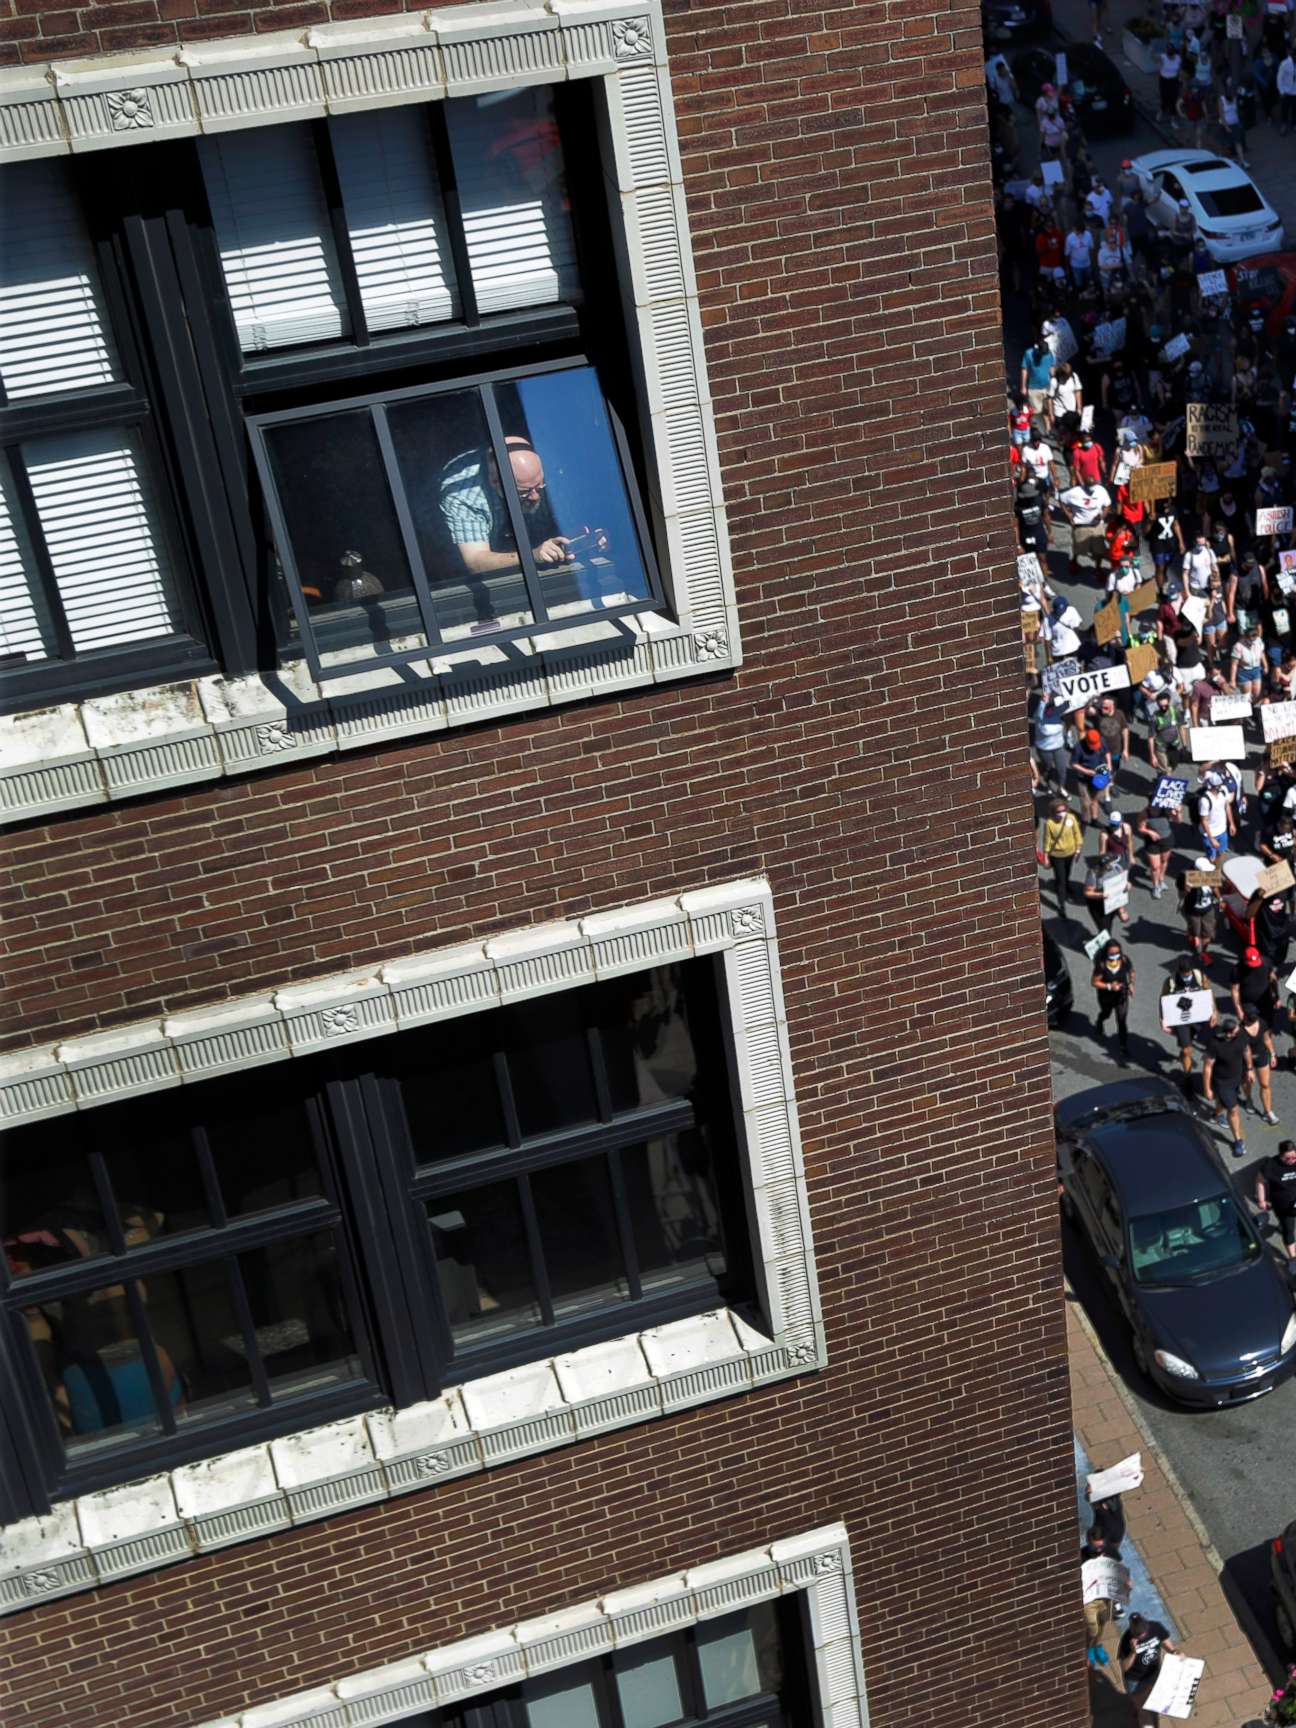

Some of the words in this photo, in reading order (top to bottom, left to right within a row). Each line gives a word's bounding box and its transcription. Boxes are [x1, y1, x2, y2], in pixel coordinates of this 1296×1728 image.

[1157, 515, 1175, 540] X
[1061, 671, 1110, 697] VOTE
[1161, 779, 1184, 791] BLACK
